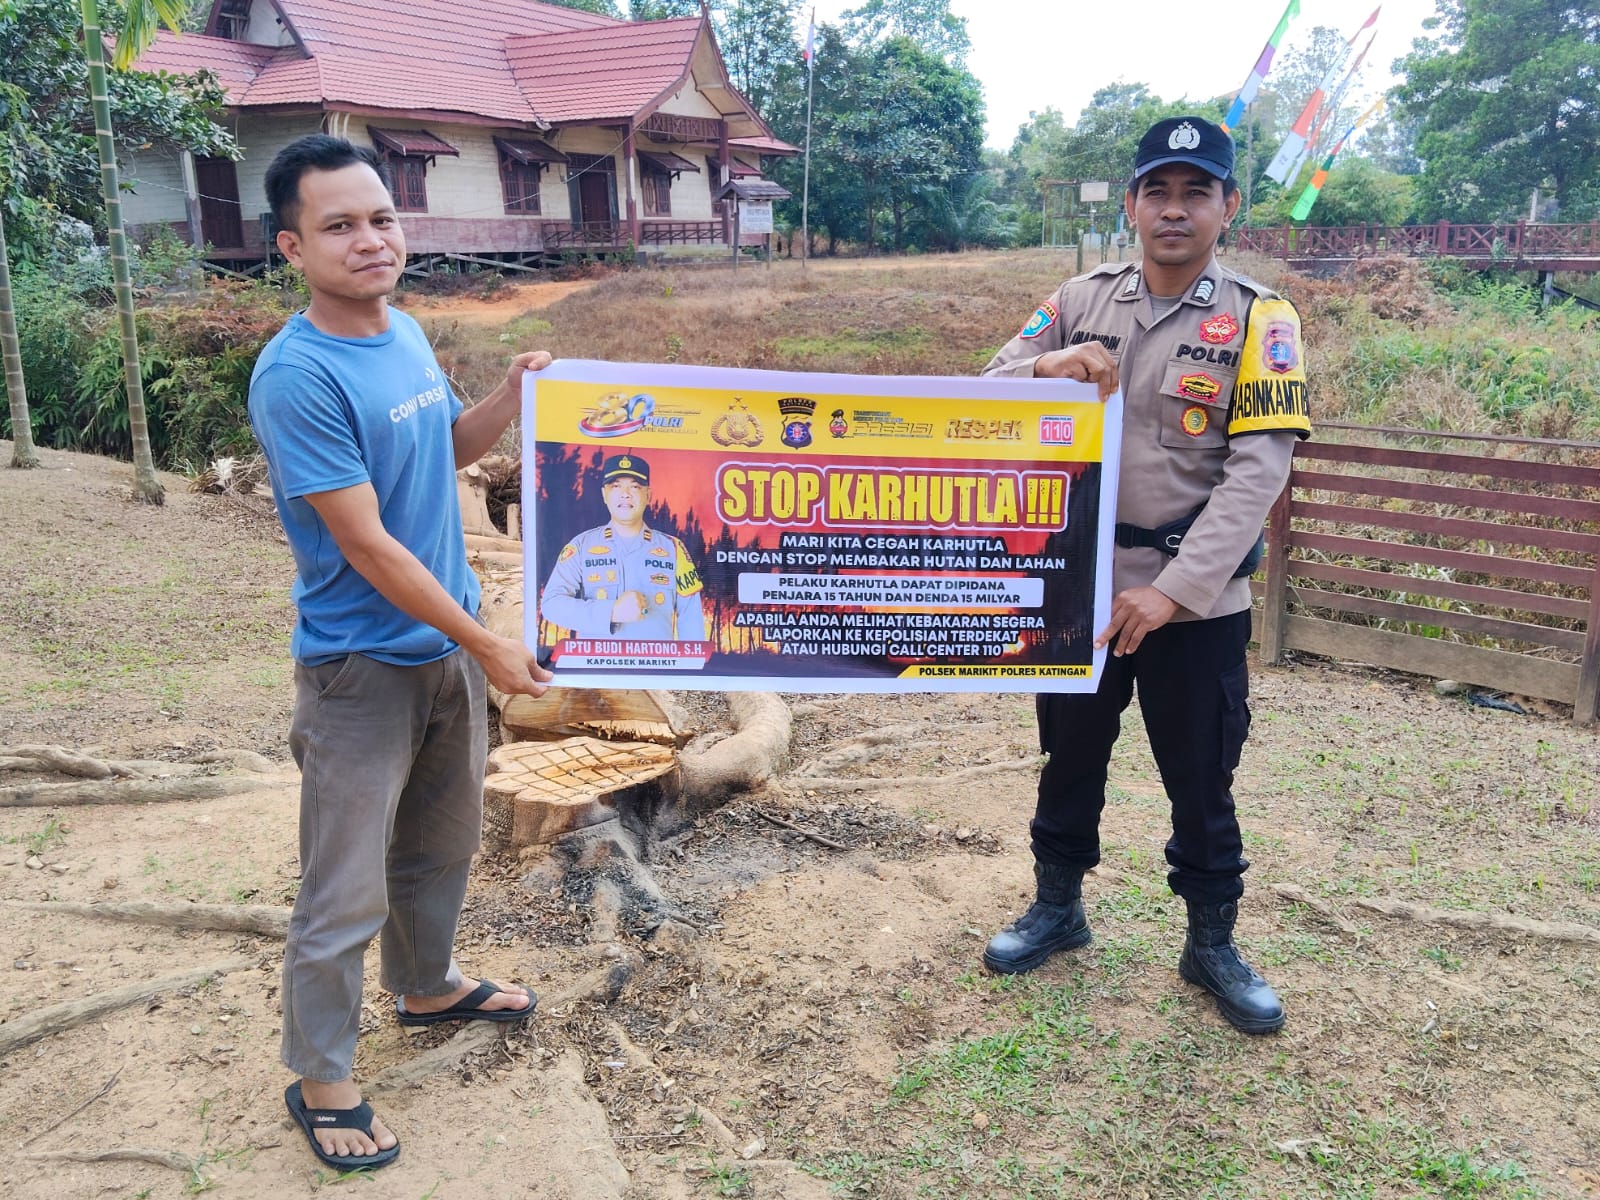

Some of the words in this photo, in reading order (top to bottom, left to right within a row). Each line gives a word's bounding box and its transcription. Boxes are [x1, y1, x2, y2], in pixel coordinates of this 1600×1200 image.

[1176, 343, 1239, 368] POLRI
[389, 386, 446, 423] CONVERSE
[643, 415, 684, 427] POLRI
[945, 418, 1023, 440] RESPEK
[1041, 422, 1072, 440] 110
[723, 469, 820, 519] STOP
[829, 473, 1018, 524] KARHUTLA
[782, 535, 824, 548] MARI
[827, 536, 862, 549] KITA
[865, 537, 919, 550] CEGAH
[923, 538, 1005, 552] KARHUTLA
[645, 559, 674, 571] POLRI
[716, 551, 783, 564] DENGAN
[786, 553, 828, 565] STOP
[830, 554, 920, 567] MEMBAKAR
[924, 555, 977, 568] HUTAN
[980, 557, 1012, 569] DAN
[1015, 558, 1065, 570] LAHAN
[778, 577, 828, 588] PELAKU
[830, 578, 898, 589] KARHUTLA
[901, 580, 943, 590] DAPAT
[944, 581, 1006, 591] DIPIDANA
[762, 590, 822, 601] PENJARA
[824, 592, 836, 602] 15
[838, 592, 882, 602] TAHUN
[885, 593, 913, 603] DAN
[915, 593, 959, 604] DENDA
[961, 594, 973, 603] 15
[975, 594, 1021, 604] MILYAR
[735, 613, 797, 626] APABILA
[798, 614, 840, 626] ANDA
[842, 614, 904, 627] MELIHAT
[906, 615, 990, 628] KEBAKARAN
[992, 616, 1045, 629] SEGERA
[764, 628, 842, 641] LAPORKAN
[845, 629, 863, 641] KE
[865, 629, 948, 642] KEPOLISIAN
[950, 630, 1019, 642] TERDEKAT
[564, 641, 591, 654] IPTU
[594, 641, 622, 655] BUDI
[625, 642, 682, 657] HARTONO,
[684, 643, 706, 656] S.H.
[781, 643, 819, 655] ATAU
[821, 643, 886, 656] HUBUNGI
[889, 644, 924, 656] CALL
[926, 644, 980, 656] CENTER
[982, 645, 1002, 656] 110
[586, 658, 636, 666] KAPOLSEK
[638, 658, 677, 667] MARIKIT
[919, 667, 956, 676] POLSEK
[958, 667, 998, 676] MARIKIT
[1000, 668, 1037, 676] POLRES
[1039, 668, 1087, 676] KATINGAN
